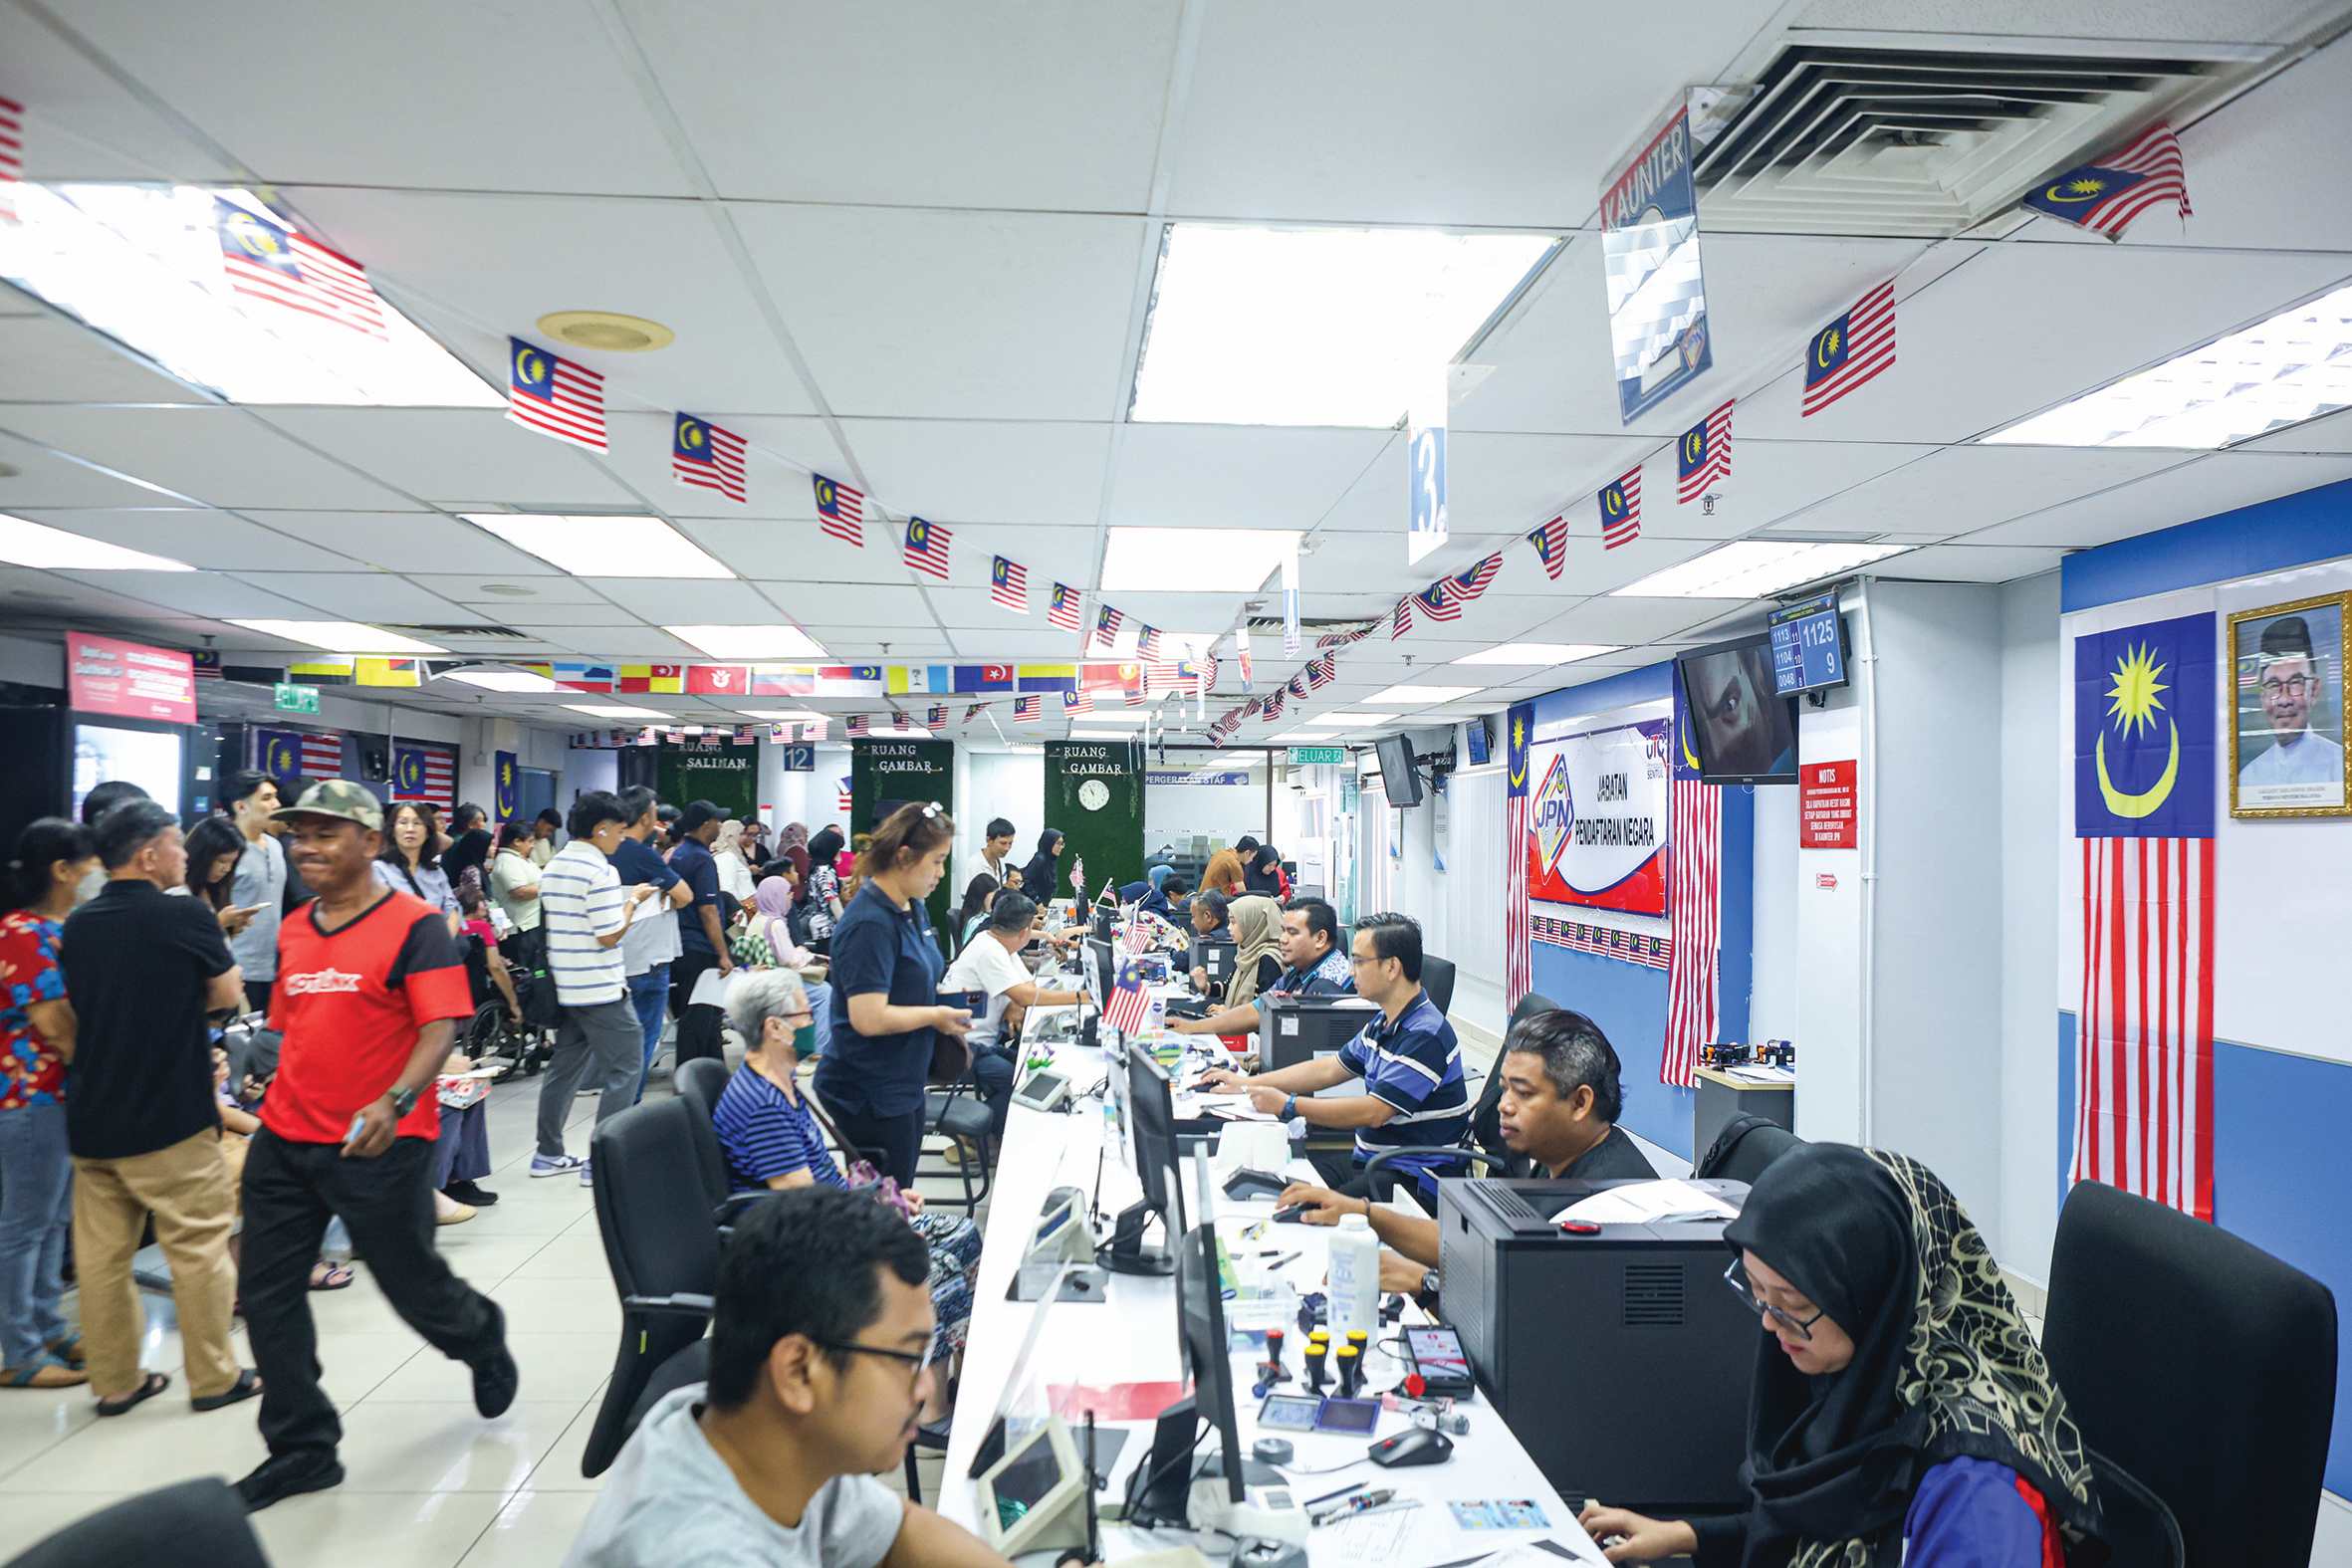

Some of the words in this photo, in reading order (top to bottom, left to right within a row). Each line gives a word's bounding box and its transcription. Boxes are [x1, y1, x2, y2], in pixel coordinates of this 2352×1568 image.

[1604, 120, 1685, 233] KAUNTER
[1773, 628, 1790, 643] 1113
[1803, 619, 1834, 647] 1125
[1826, 652, 1835, 674] 9
[871, 745, 916, 756] RUANG
[1063, 747, 1106, 758] RUANG
[1291, 748, 1331, 763] KELUAR
[686, 757, 747, 770] SALINAN
[786, 748, 808, 770] 12
[879, 761, 932, 772] GAMBAR
[1069, 763, 1121, 774] GAMBAR
[1819, 769, 1835, 784] NOTIS
[1596, 773, 1628, 802] JABATAN
[1536, 799, 1570, 828] JPN
[1575, 818, 1622, 845] PENDAFTARAN
[1623, 816, 1655, 846] NEGARA
